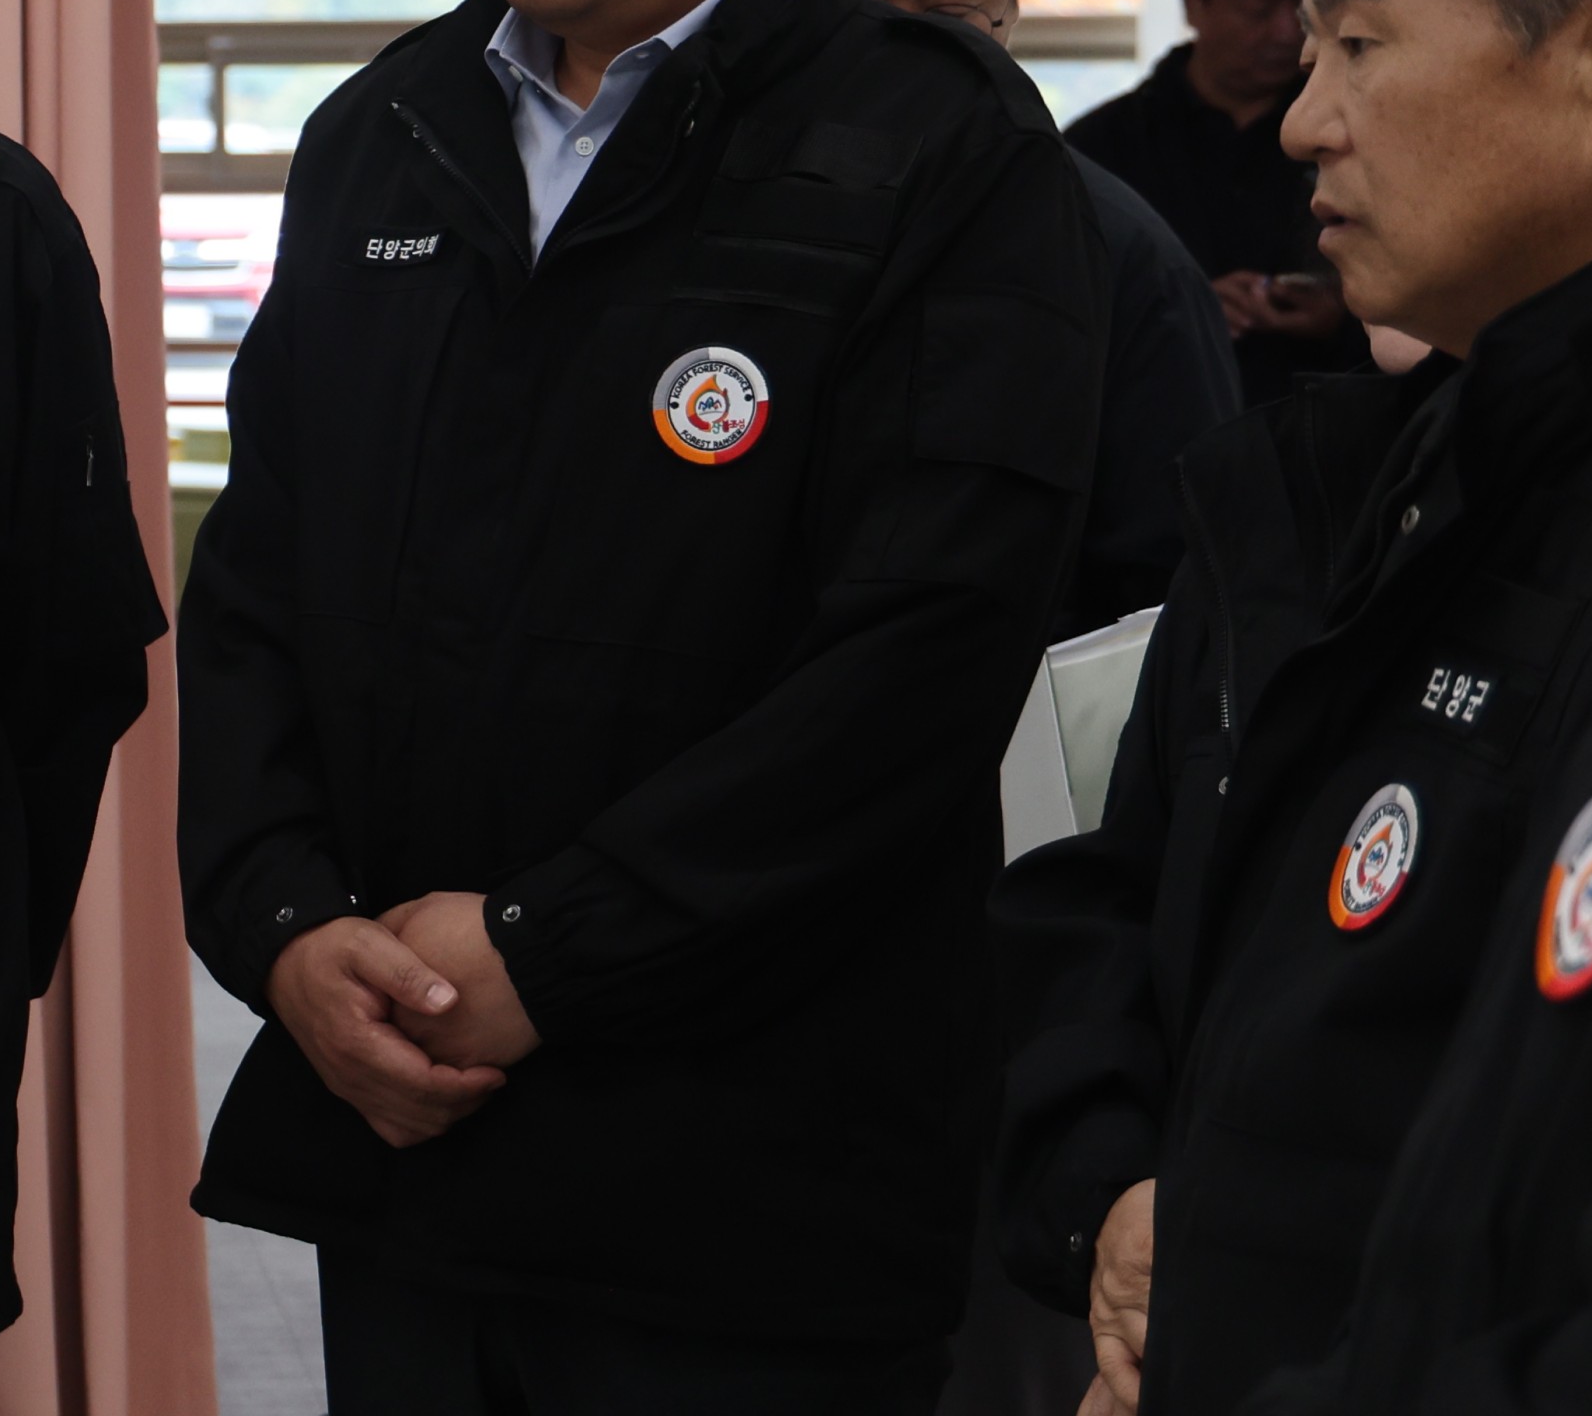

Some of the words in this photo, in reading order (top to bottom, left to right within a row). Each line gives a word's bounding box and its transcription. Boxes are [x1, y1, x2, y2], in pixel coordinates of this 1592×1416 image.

[365, 234, 440, 261] 단양군의회
[672, 372, 692, 399] KOREA
[692, 363, 724, 377] FOREST
[723, 367, 750, 394] SERVICE
[680, 429, 711, 449] FOREST
[712, 428, 743, 449] RANGER
[1420, 667, 1491, 723] 단양군
